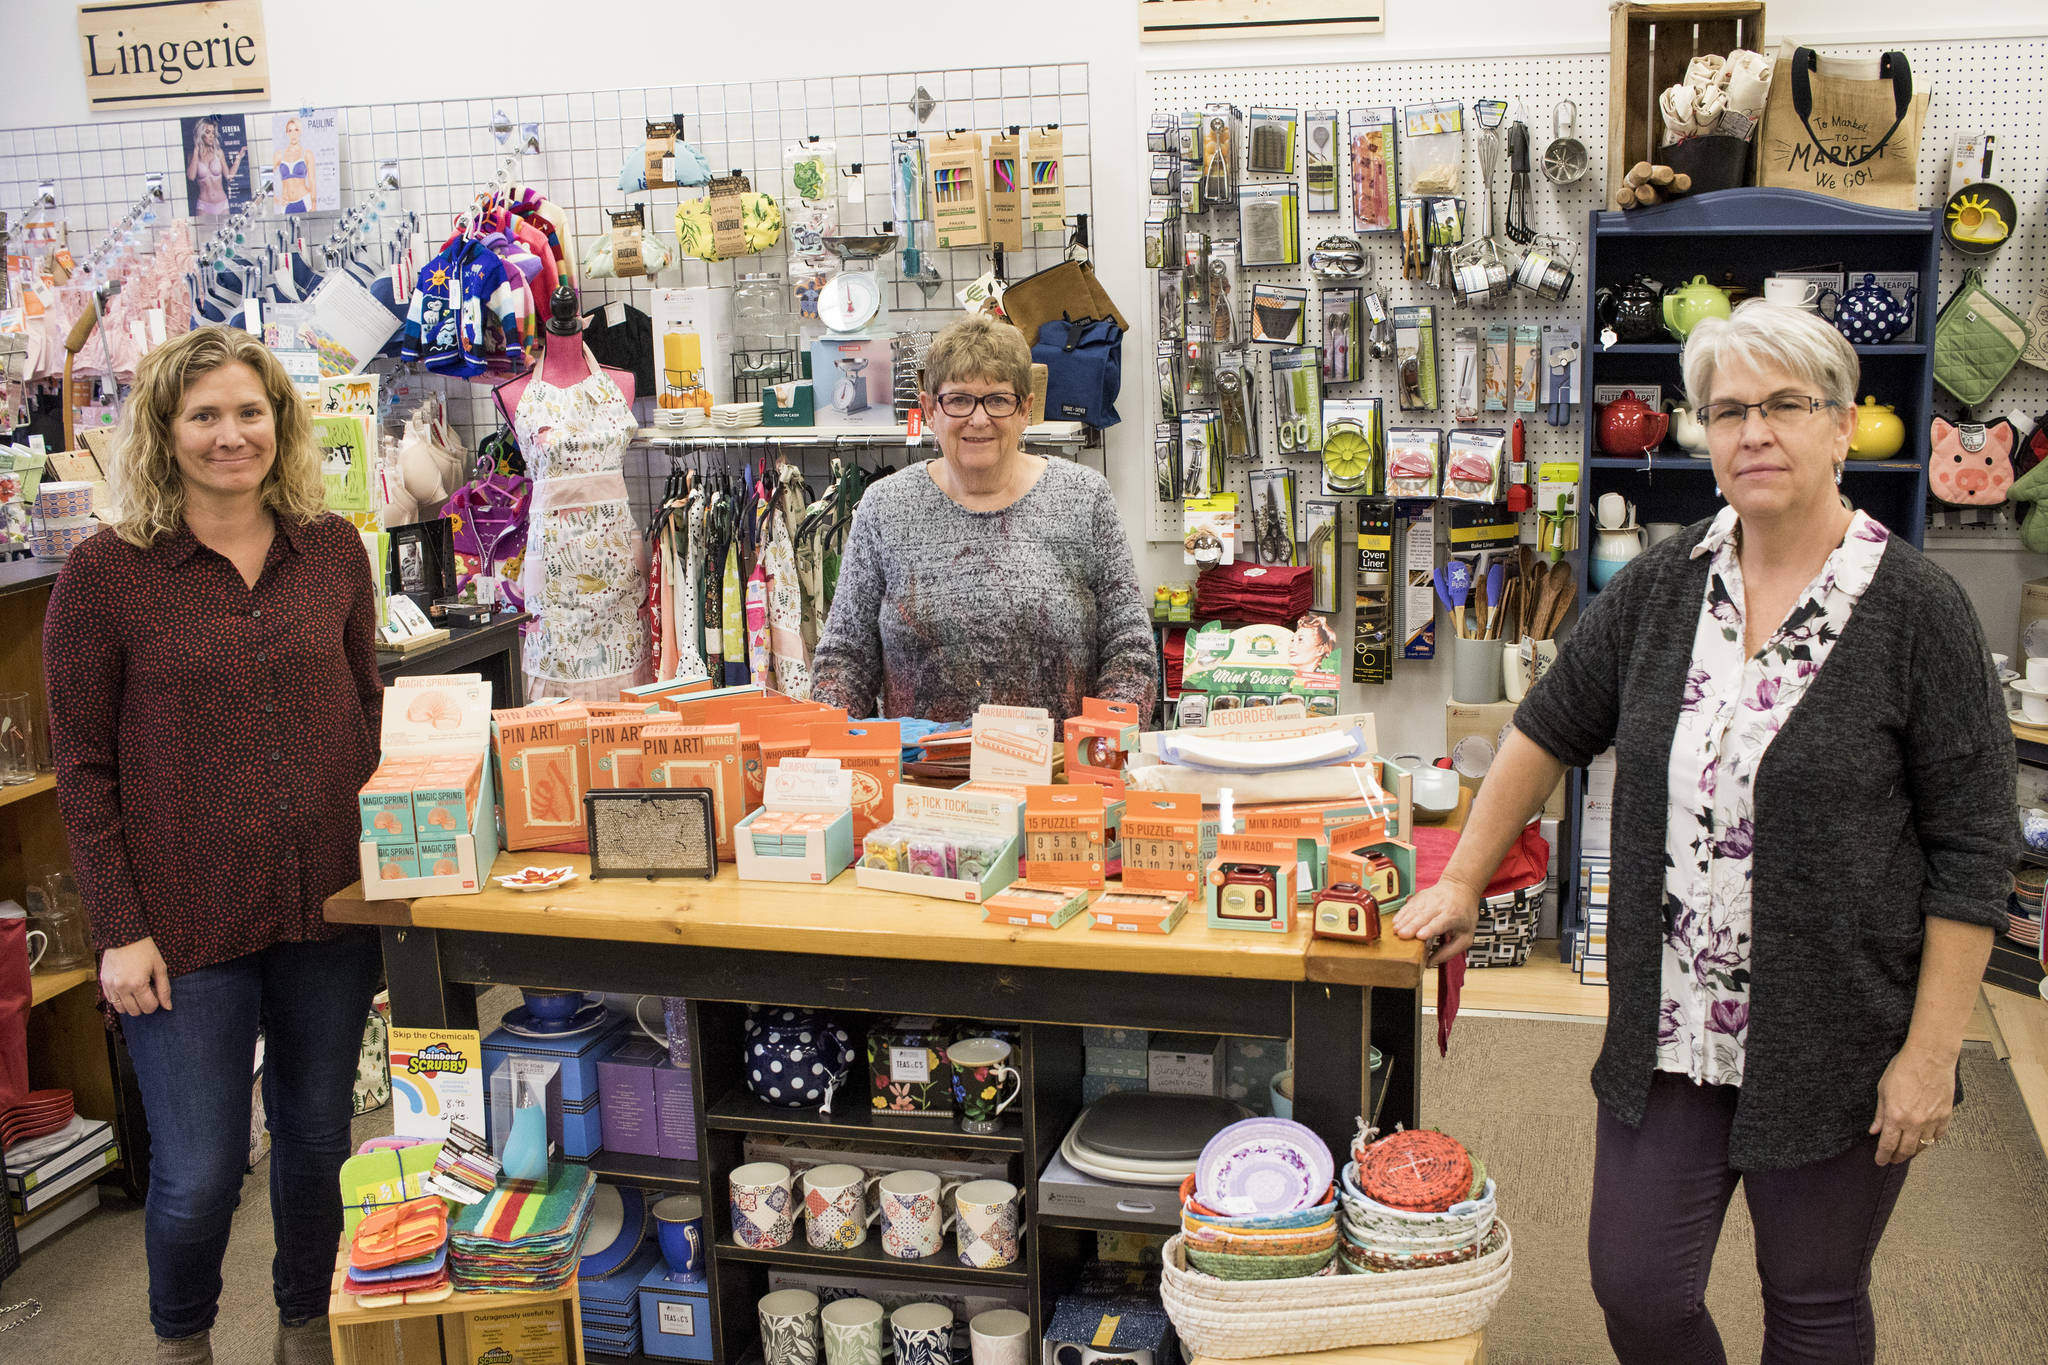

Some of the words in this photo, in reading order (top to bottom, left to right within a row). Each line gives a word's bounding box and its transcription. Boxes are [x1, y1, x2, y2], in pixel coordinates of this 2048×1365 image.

[83, 22, 257, 85] Lingerie
[307, 117, 335, 129] PAULINE
[1812, 116, 1828, 129] To
[221, 125, 241, 134] SERENA
[1835, 133, 1849, 143] TO
[1385, 132, 1394, 163] PASTRY
[1787, 142, 1888, 173] MARKET
[1815, 170, 1837, 190] We
[1843, 167, 1874, 189] GO!
[1387, 165, 1396, 206] COMPASS
[1882, 281, 1913, 289] TEAPOT
[1362, 550, 1386, 559] Oven
[1362, 559, 1385, 568] Liner
[398, 679, 425, 689] MAGIC
[425, 677, 460, 688] SPRING
[1212, 669, 1247, 685] Mint
[1247, 670, 1290, 686] Boxes
[496, 711, 520, 721] PIN
[525, 708, 551, 719] ART
[980, 707, 1026, 719] HARMONICA
[1213, 707, 1274, 727] RECORDER
[559, 720, 588, 731] VINTAGE
[501, 727, 525, 745] PIN
[530, 724, 556, 742] ART
[591, 727, 615, 745] PIN
[643, 739, 668, 756] PIN
[673, 737, 700, 754] ART
[703, 735, 734, 746] VINTAGE
[780, 760, 817, 772] COMPASS
[847, 758, 880, 768] CUSHION
[362, 796, 383, 806] MAGIC
[384, 795, 409, 805] SPRING
[416, 792, 437, 802] MAGIC
[437, 791, 463, 800] SPRING
[921, 795, 941, 810] TICK
[943, 798, 968, 813] TOCK
[1028, 817, 1039, 829] 15
[1041, 817, 1077, 830] PUZZLE
[1248, 818, 1269, 830] MINI
[1271, 817, 1300, 830] RADIO
[1124, 823, 1135, 835] 15
[1137, 824, 1172, 838] PUZZLE
[1332, 831, 1348, 845] MINI
[1349, 826, 1370, 841] RADIO
[1037, 837, 1044, 849] 9
[1053, 836, 1060, 848] 5
[1071, 837, 1077, 849] 6
[1220, 838, 1242, 851] MINI
[1243, 840, 1273, 853] RADIO
[378, 848, 390, 857] GIC
[390, 847, 415, 857] SPRING
[421, 844, 443, 854] MAGIC
[1135, 843, 1141, 856] 9
[1151, 844, 1157, 857] 6
[1168, 845, 1175, 857] 3
[1035, 853, 1046, 862] 13
[1052, 852, 1064, 862] 10
[1070, 853, 1080, 862] 11
[1133, 860, 1143, 868] 13
[1150, 861, 1160, 869] 10
[1168, 861, 1175, 869] 7
[393, 1031, 412, 1040] Skip
[429, 1032, 476, 1041] Chemicals
[418, 1050, 462, 1061] Rainbow
[408, 1058, 467, 1074] SCRUBBY
[896, 1061, 910, 1069] TEAS
[1153, 1064, 1184, 1078] Sunny
[1184, 1066, 1208, 1080] Day
[1158, 1079, 1186, 1088] HONEY
[440, 1112, 449, 1121] 2
[474, 1312, 520, 1322] Outrageously
[522, 1310, 543, 1318] useful
[664, 1314, 677, 1322] TEAS
